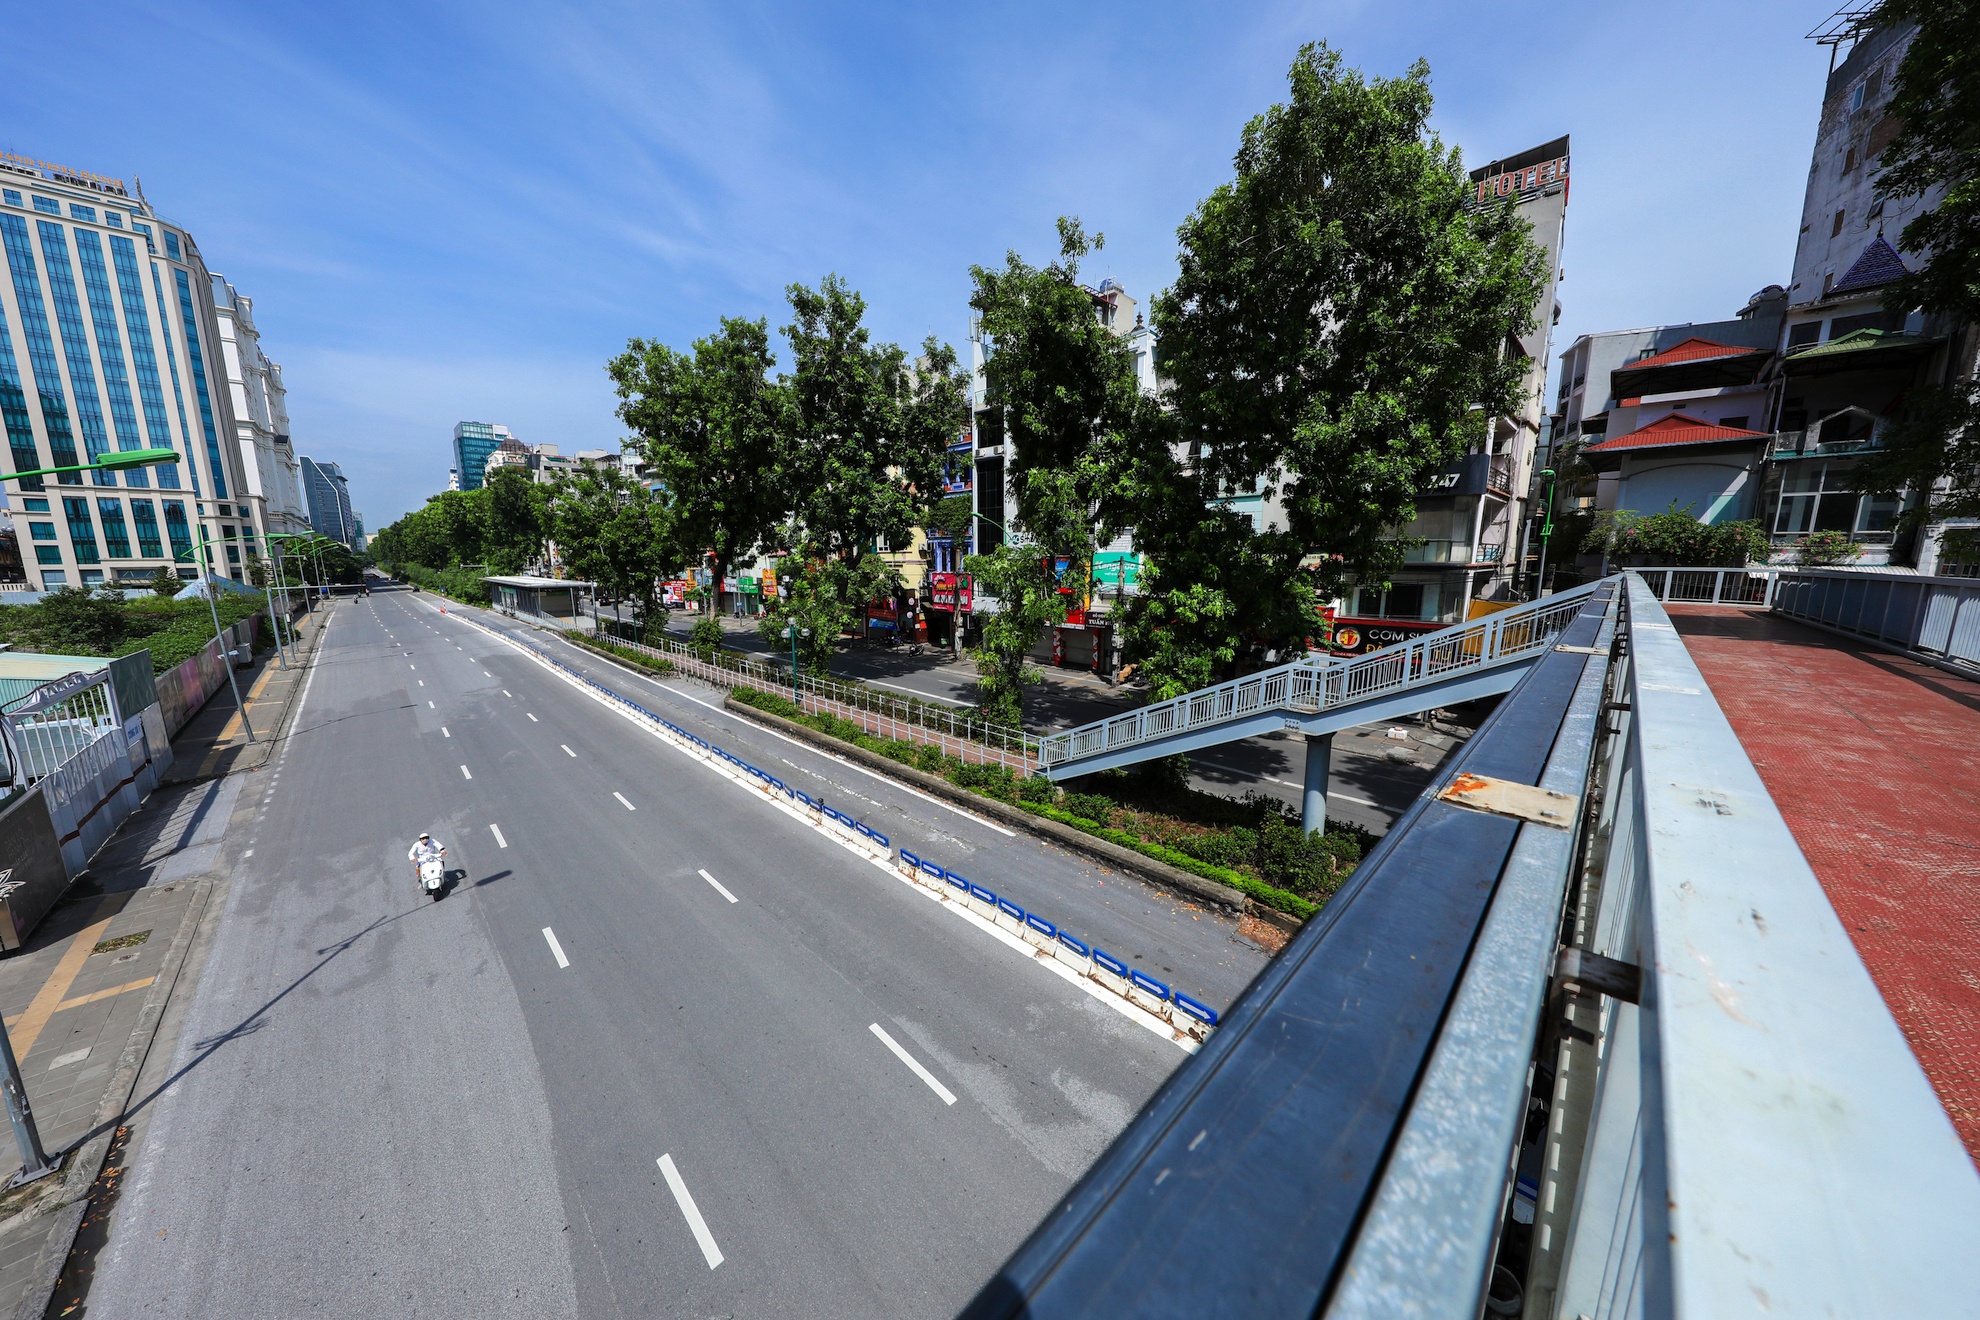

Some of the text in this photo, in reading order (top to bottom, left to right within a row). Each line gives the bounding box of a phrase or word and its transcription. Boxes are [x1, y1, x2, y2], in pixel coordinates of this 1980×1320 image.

[37, 160, 77, 176] VISTA
[80, 170, 123, 187] HANOI
[1477, 155, 1570, 203] HOTEL
[1094, 561, 1137, 572] Kangaoo
[1368, 629, 1405, 642] CƠM
